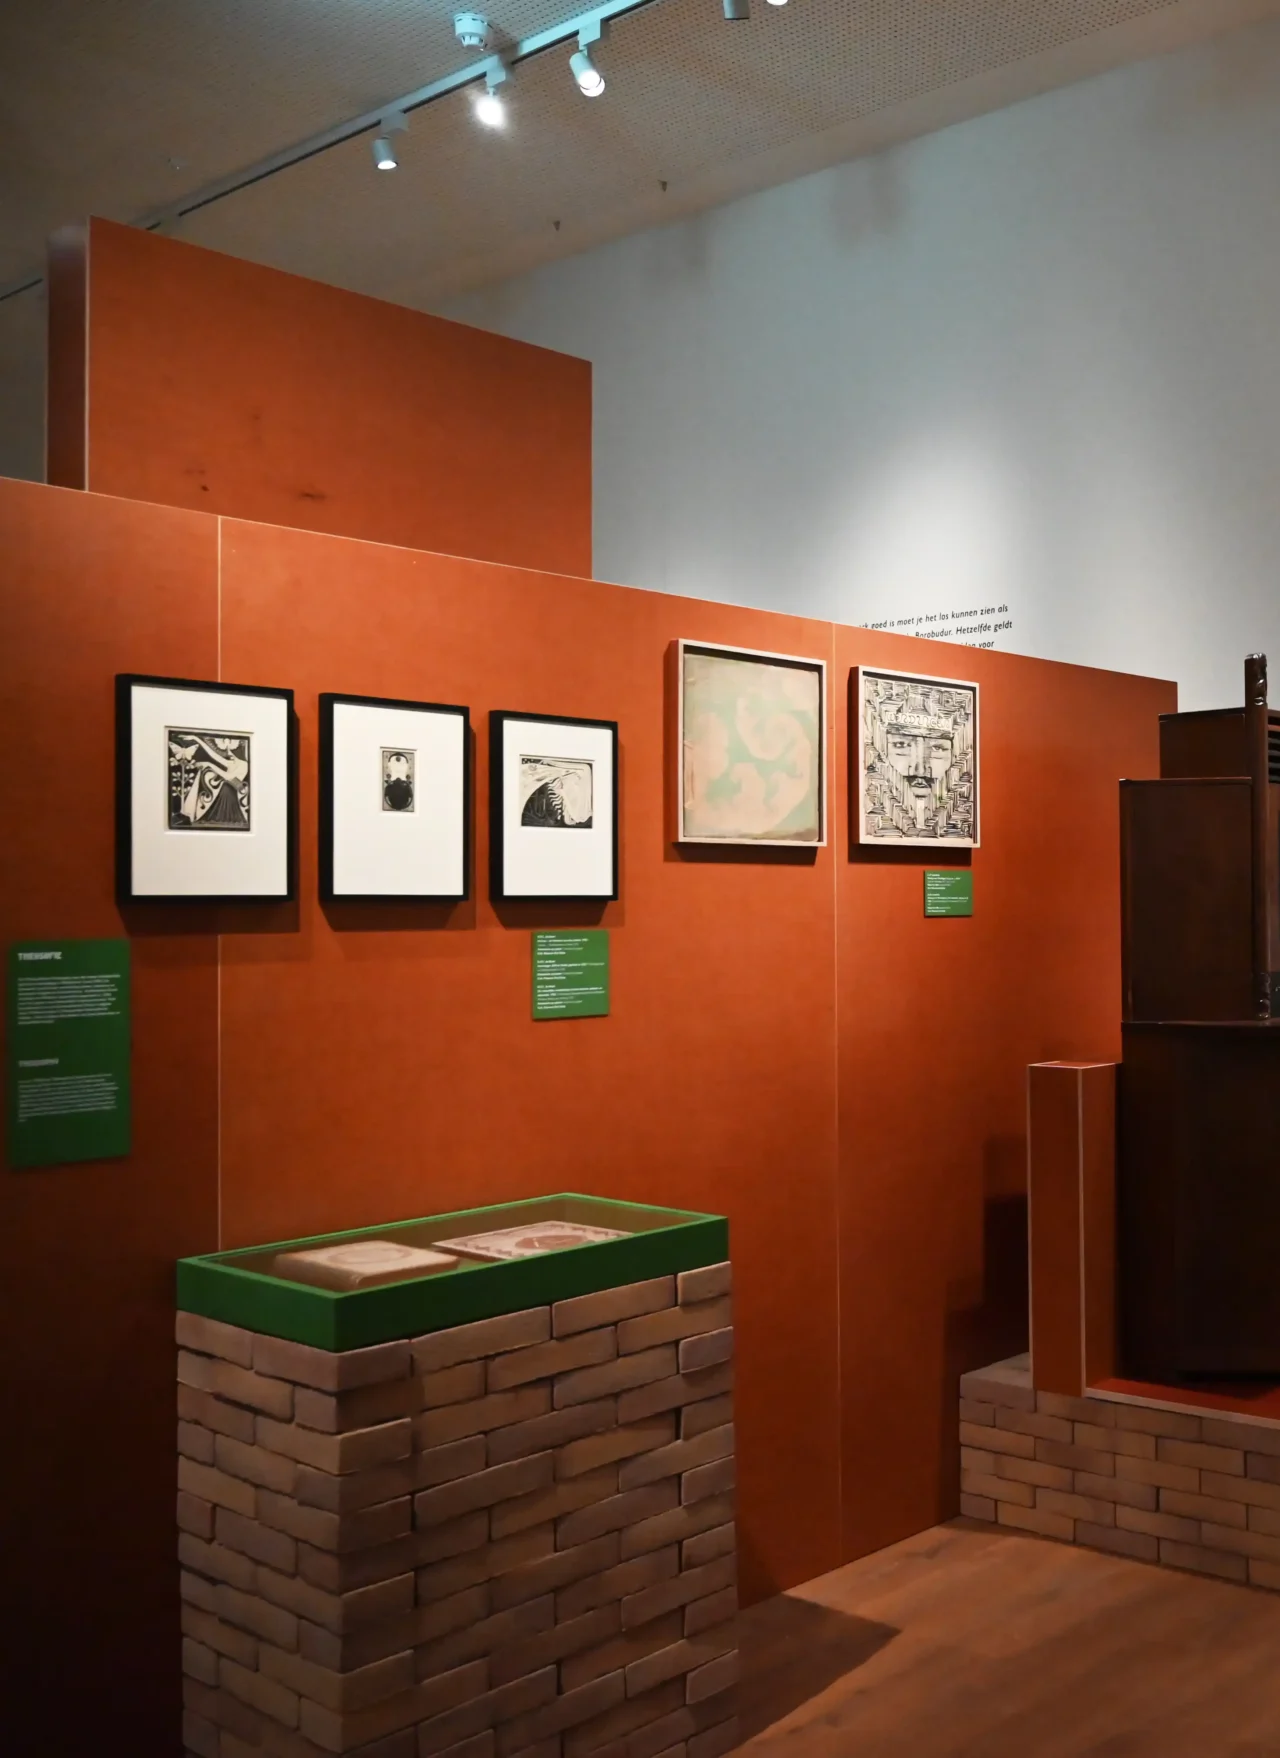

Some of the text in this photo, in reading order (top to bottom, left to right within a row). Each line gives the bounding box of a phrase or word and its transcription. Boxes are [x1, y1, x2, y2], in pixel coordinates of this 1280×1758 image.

[897, 618, 914, 626] moet
[916, 616, 923, 626] je
[926, 614, 937, 622] het
[939, 612, 949, 620] los
[951, 610, 978, 619] kunnen
[980, 606, 996, 616] zien
[998, 604, 1008, 613] als
[956, 623, 992, 634] Hetzelfde
[994, 620, 1012, 632] geldt
